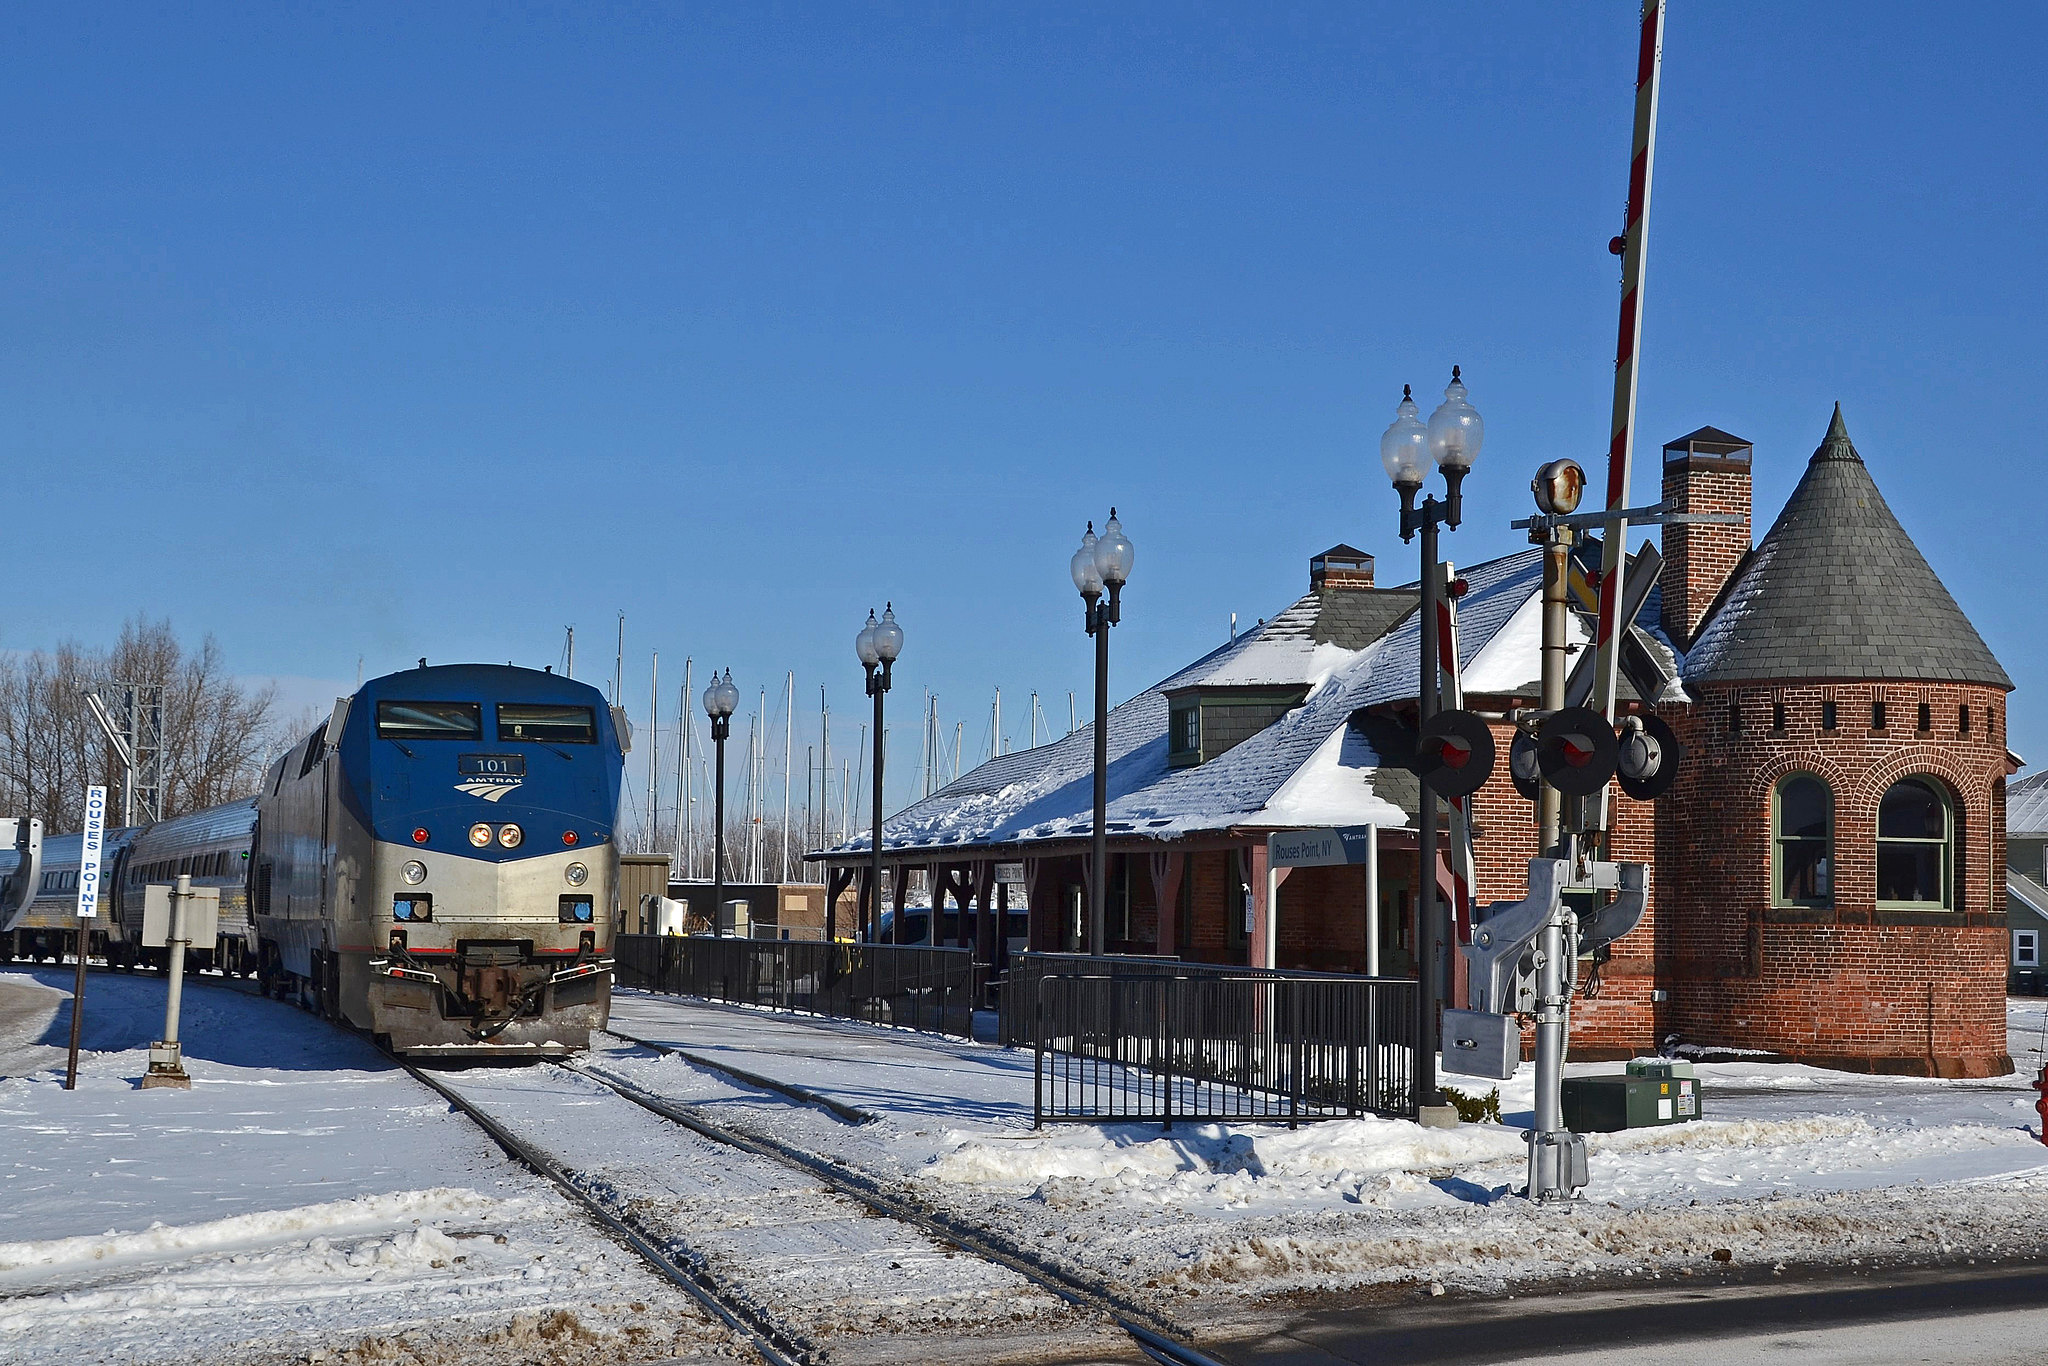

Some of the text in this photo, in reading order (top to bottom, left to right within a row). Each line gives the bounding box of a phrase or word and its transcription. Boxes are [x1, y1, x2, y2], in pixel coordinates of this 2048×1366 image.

[477, 759, 507, 772] 101
[81, 789, 103, 913] ROUSES POINT
[1275, 840, 1332, 860] Rouses Point, NY
